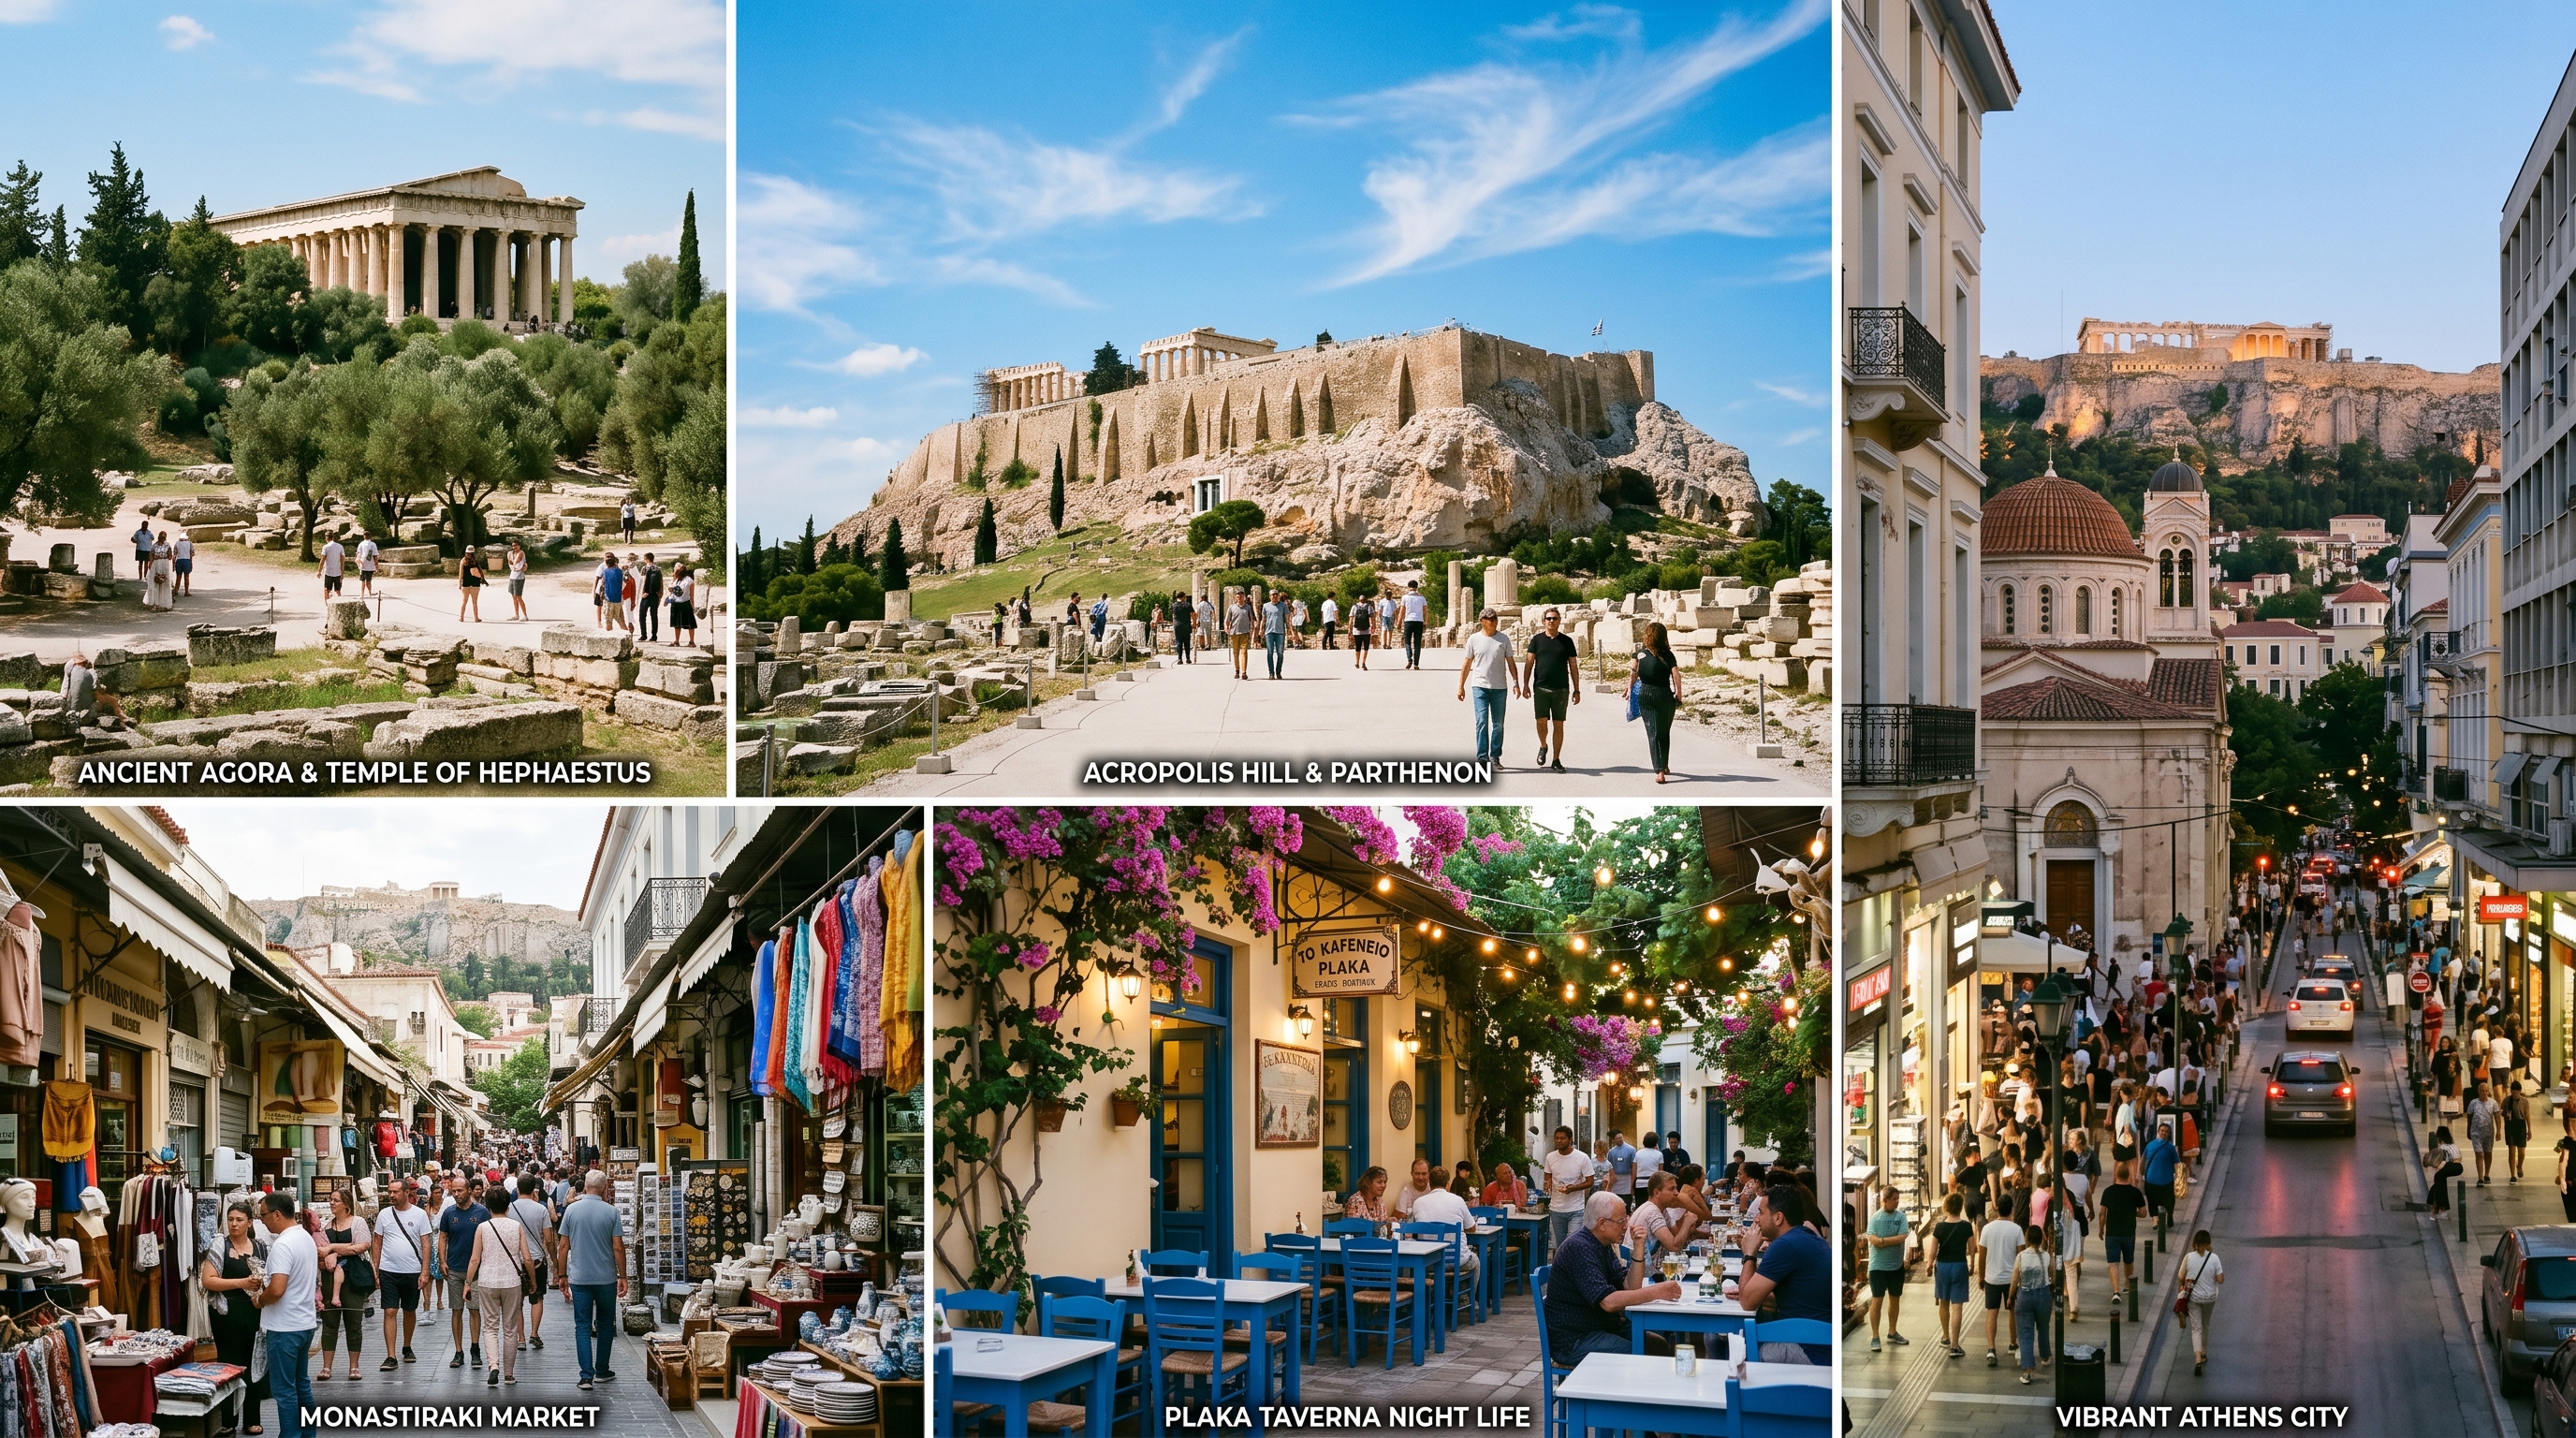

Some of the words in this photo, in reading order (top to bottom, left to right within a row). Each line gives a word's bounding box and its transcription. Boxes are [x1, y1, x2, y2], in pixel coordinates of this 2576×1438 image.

[1297, 946, 1315, 963] TO
[1320, 938, 1390, 959] KAFENEIO
[1319, 960, 1370, 976] PLAKA
